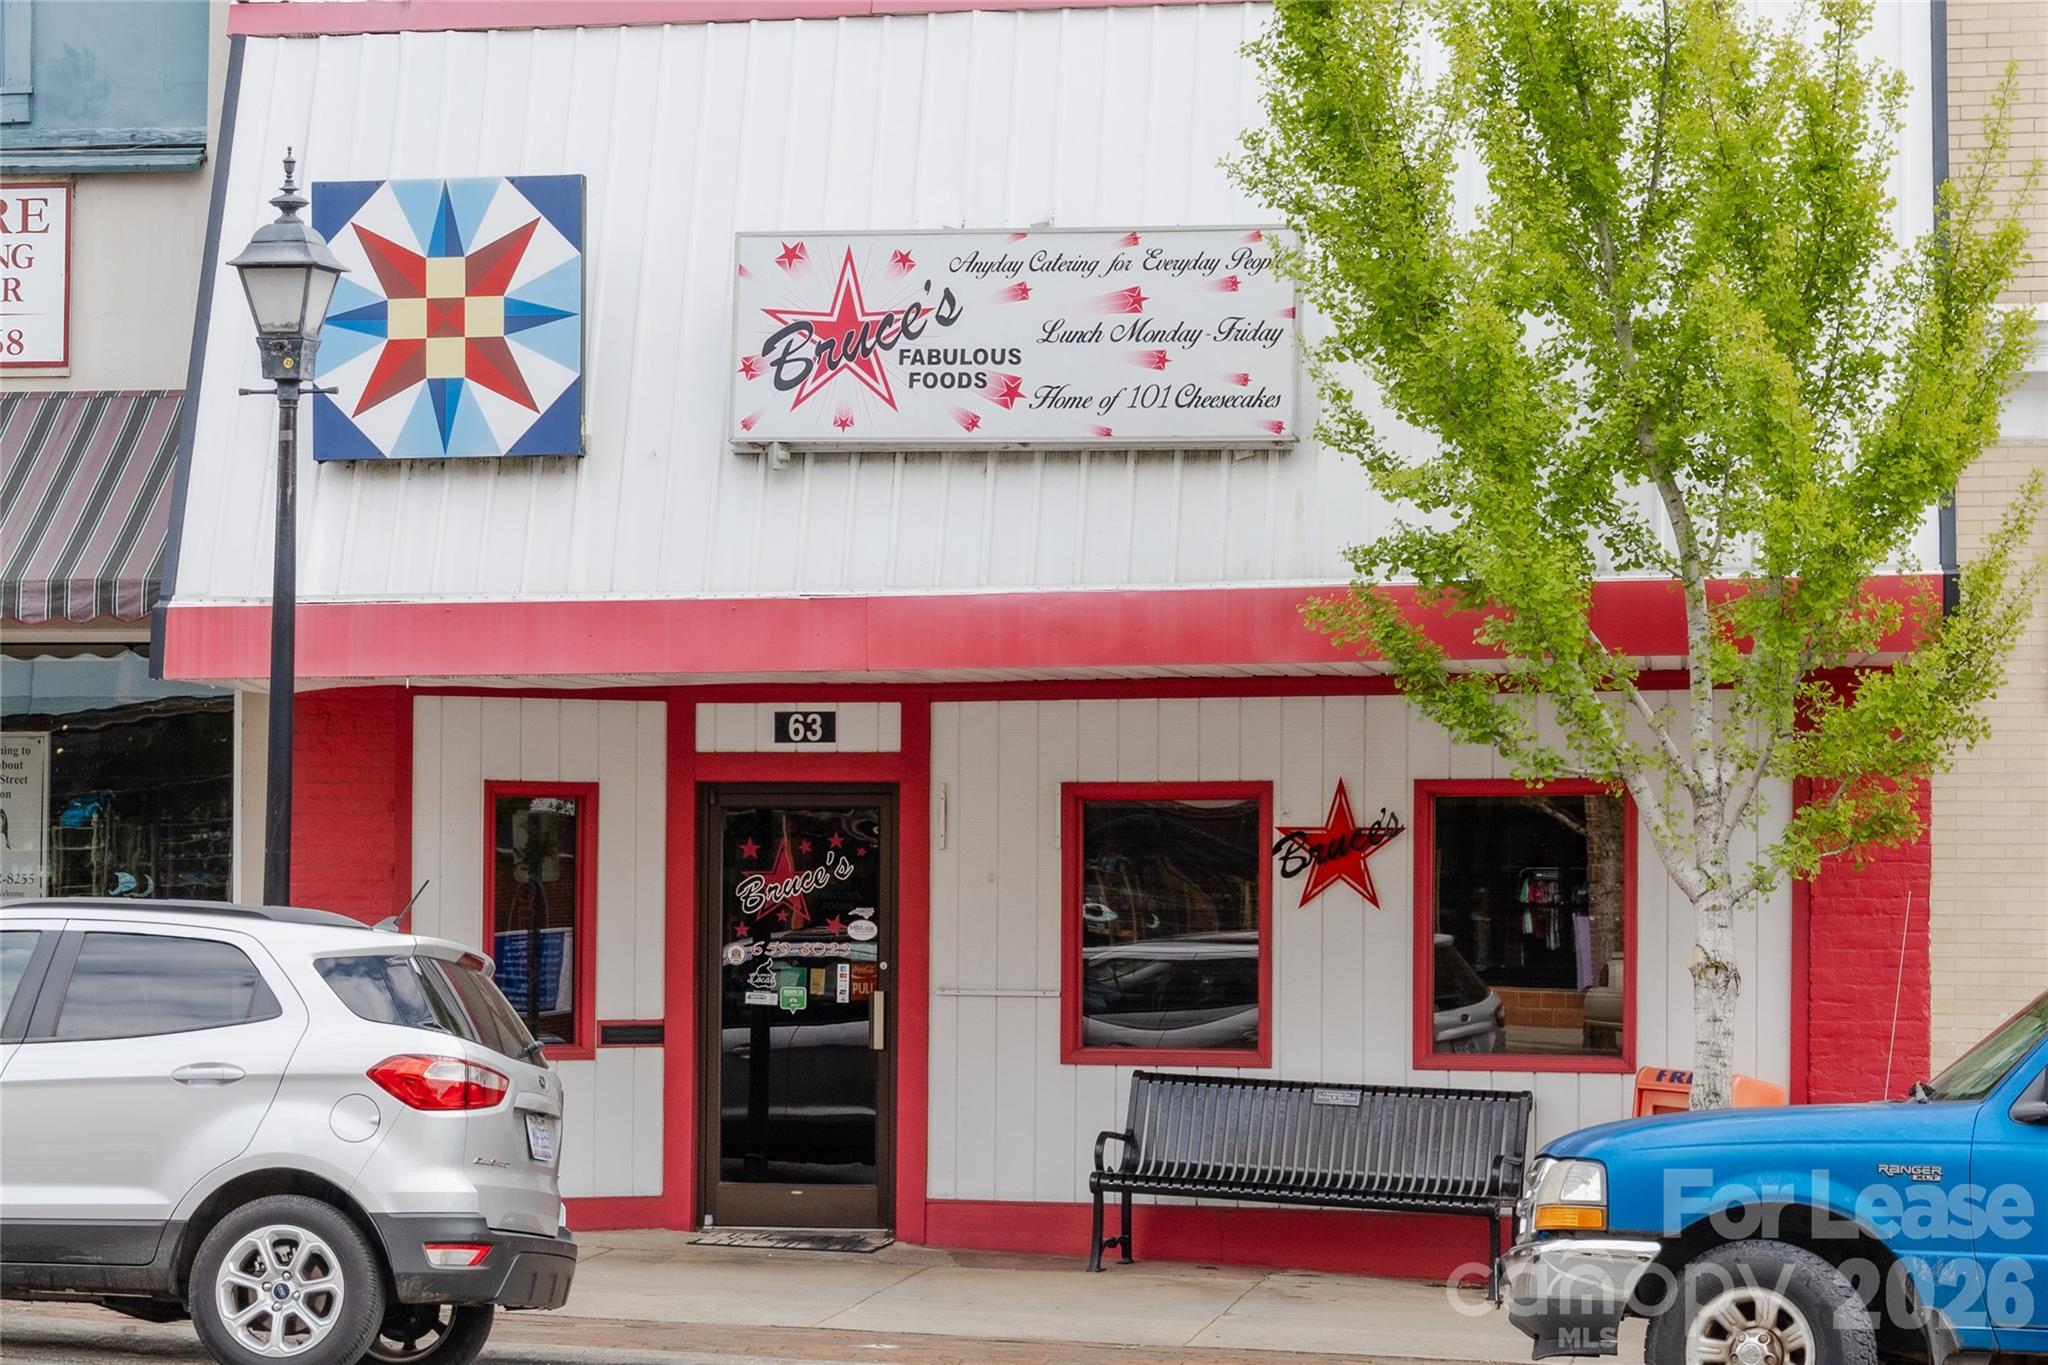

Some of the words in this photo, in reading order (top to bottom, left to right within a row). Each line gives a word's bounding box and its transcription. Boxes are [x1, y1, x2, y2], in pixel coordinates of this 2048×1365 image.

[949, 250, 1024, 279] Anyday
[1029, 249, 1100, 278] Catering
[1100, 251, 1133, 278] for
[1142, 248, 1219, 276] Everyday
[0, 329, 24, 356] 8
[761, 279, 964, 391] Bruce's
[1037, 318, 1104, 344] Lunch
[899, 348, 1022, 366] FABULOUS
[908, 372, 988, 389] FOODS
[1029, 384, 1093, 409] Home
[1098, 387, 1128, 416] of
[1127, 384, 1172, 409] 101
[1175, 383, 1282, 409] Cheesecakes
[788, 713, 823, 742] 63
[22, 747, 31, 755] to
[0, 760, 24, 770] bout
[0, 774, 28, 784] Street
[1272, 807, 1405, 879] Bruce's
[735, 850, 854, 914] Bruce's
